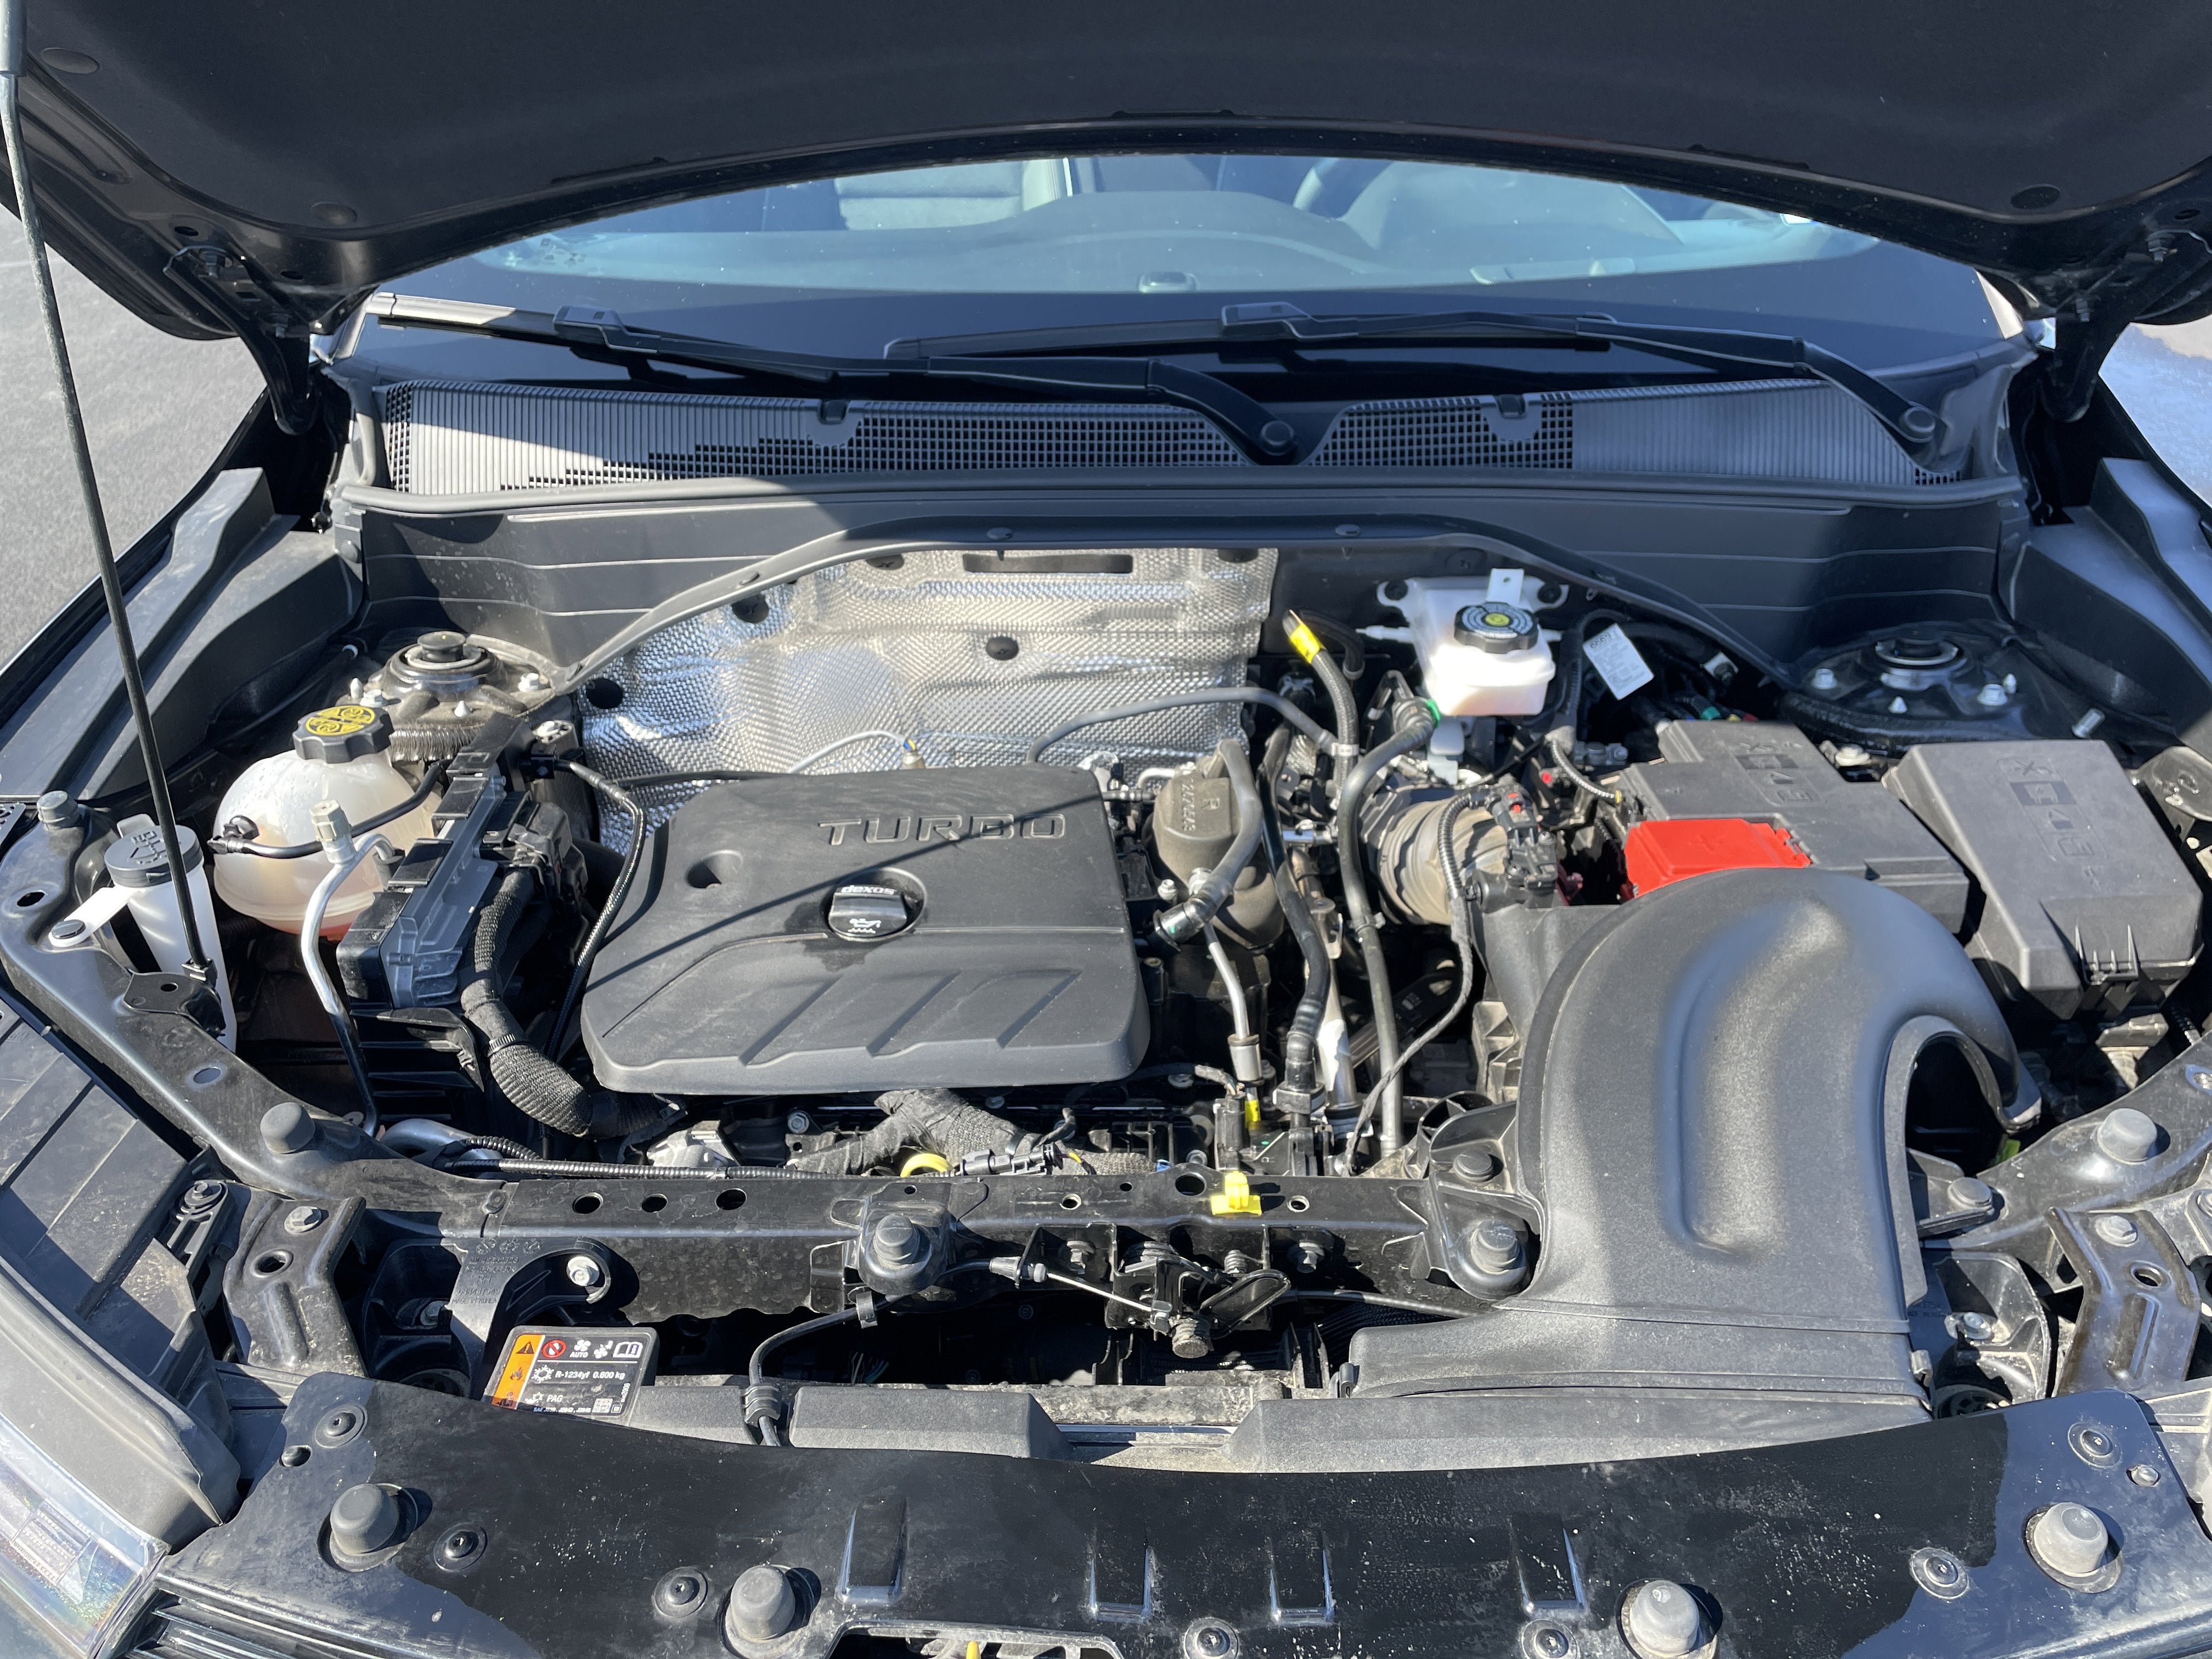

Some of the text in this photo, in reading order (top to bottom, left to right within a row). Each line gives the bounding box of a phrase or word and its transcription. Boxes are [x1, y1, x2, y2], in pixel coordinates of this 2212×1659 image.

[817, 813, 1067, 846] TURBO
[840, 884, 896, 895] dexos
[477, 1274, 492, 1284] RH
[555, 1370, 590, 1379] R-1234yf
[615, 1372, 625, 1380] kg
[546, 1394, 563, 1403] PAG
